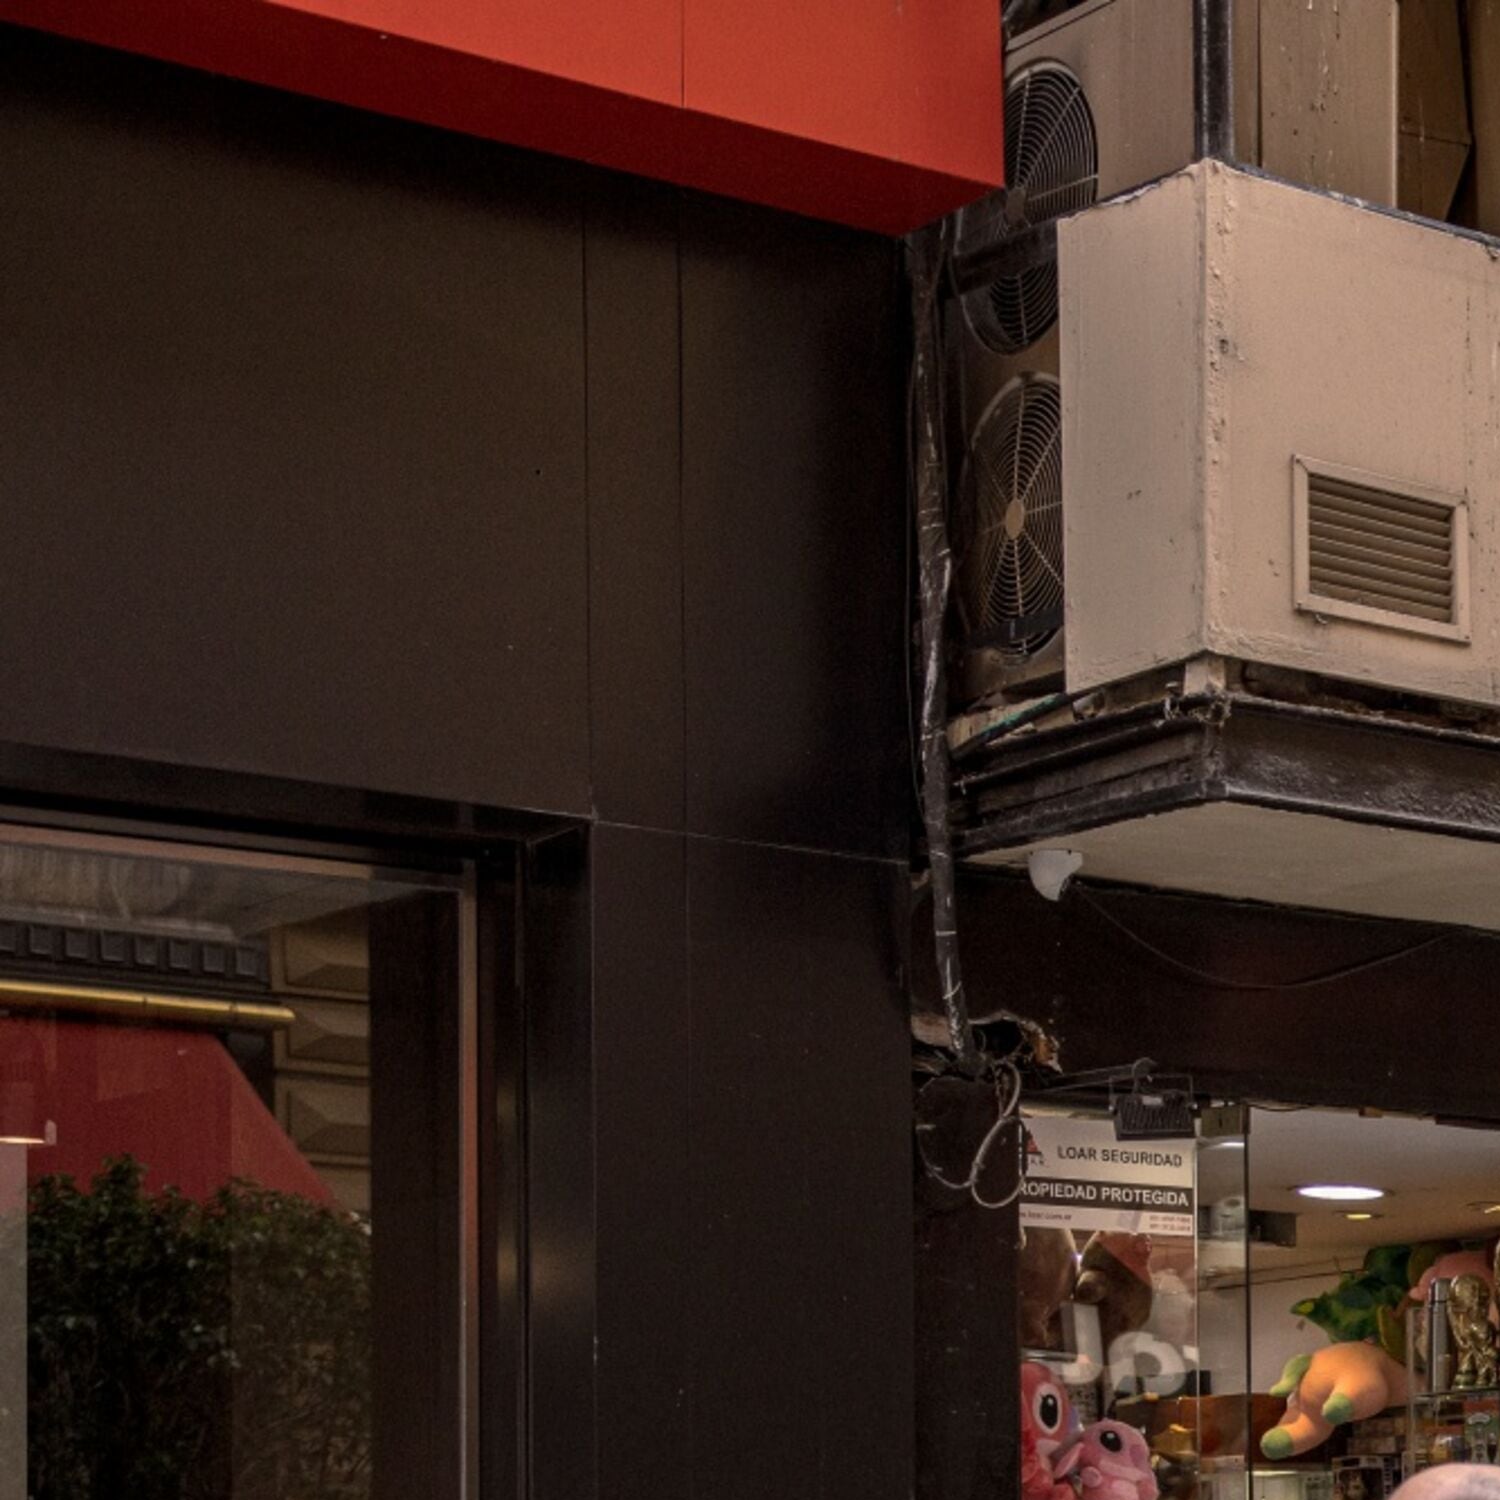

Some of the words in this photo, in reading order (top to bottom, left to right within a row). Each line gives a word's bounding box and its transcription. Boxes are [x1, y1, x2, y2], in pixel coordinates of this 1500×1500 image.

[1057, 1146, 1097, 1161] LOAR
[1100, 1149, 1182, 1167] SEGURIDAD
[1019, 1182, 1097, 1200] ROPIEDAD
[1101, 1186, 1189, 1206] PROTEGIDA
